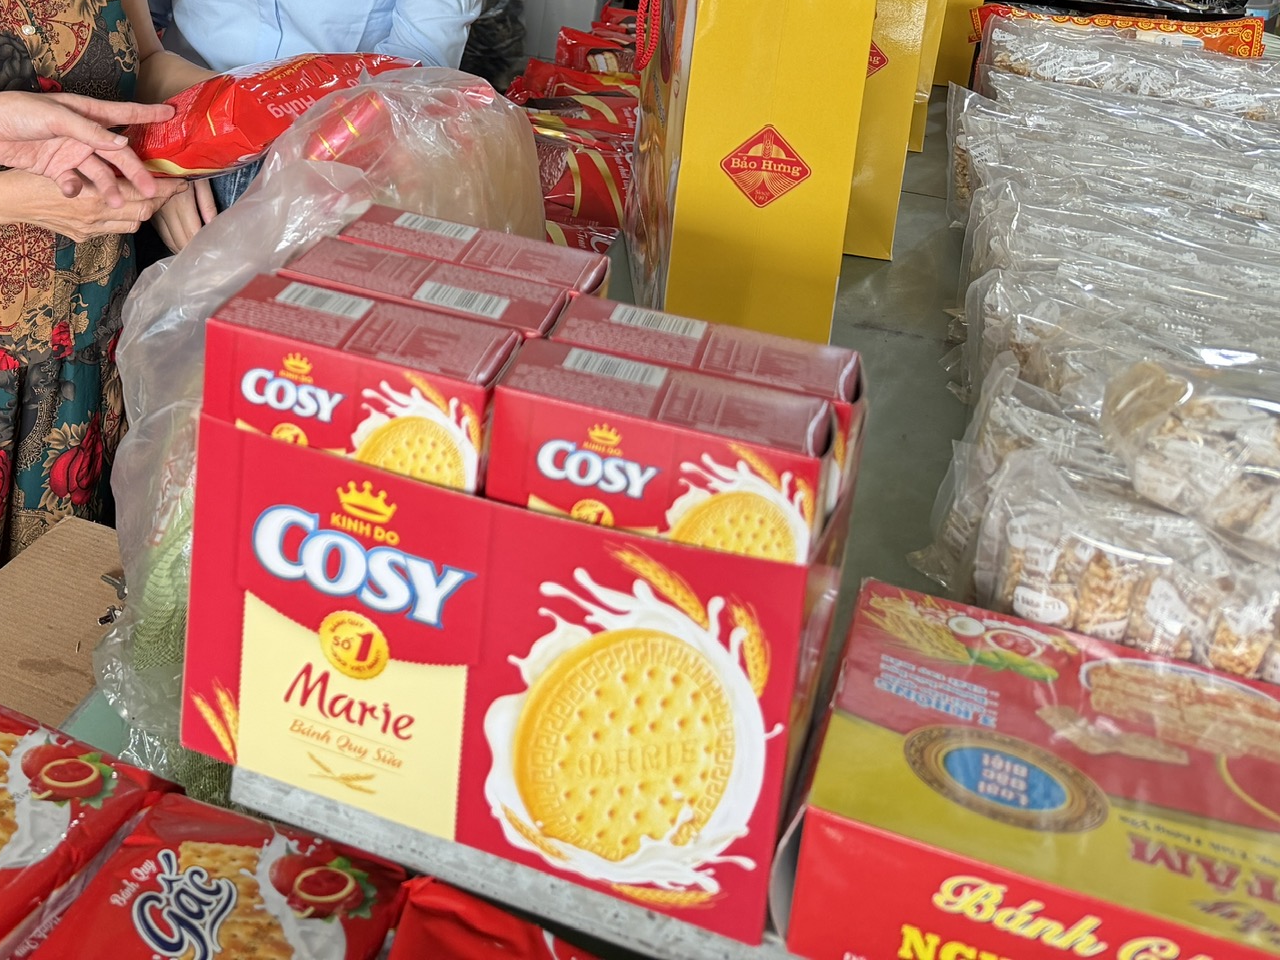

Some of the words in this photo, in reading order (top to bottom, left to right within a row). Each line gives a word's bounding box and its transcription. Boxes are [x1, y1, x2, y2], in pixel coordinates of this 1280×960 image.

[731, 156, 757, 170] Bảo
[761, 161, 801, 176] Hưng
[239, 366, 348, 424] COSY
[535, 438, 662, 499] COSY
[330, 512, 371, 539] KINH
[373, 526, 400, 546] DO
[252, 504, 478, 630] COSY
[355, 631, 374, 663] 1
[283, 662, 415, 741] Marie
[288, 718, 331, 745] Bánh
[336, 734, 369, 757] Quy
[373, 746, 403, 770] Sữa
[110, 879, 140, 907] Bánh
[131, 859, 158, 881] Quy
[932, 875, 1109, 957] Bánh
